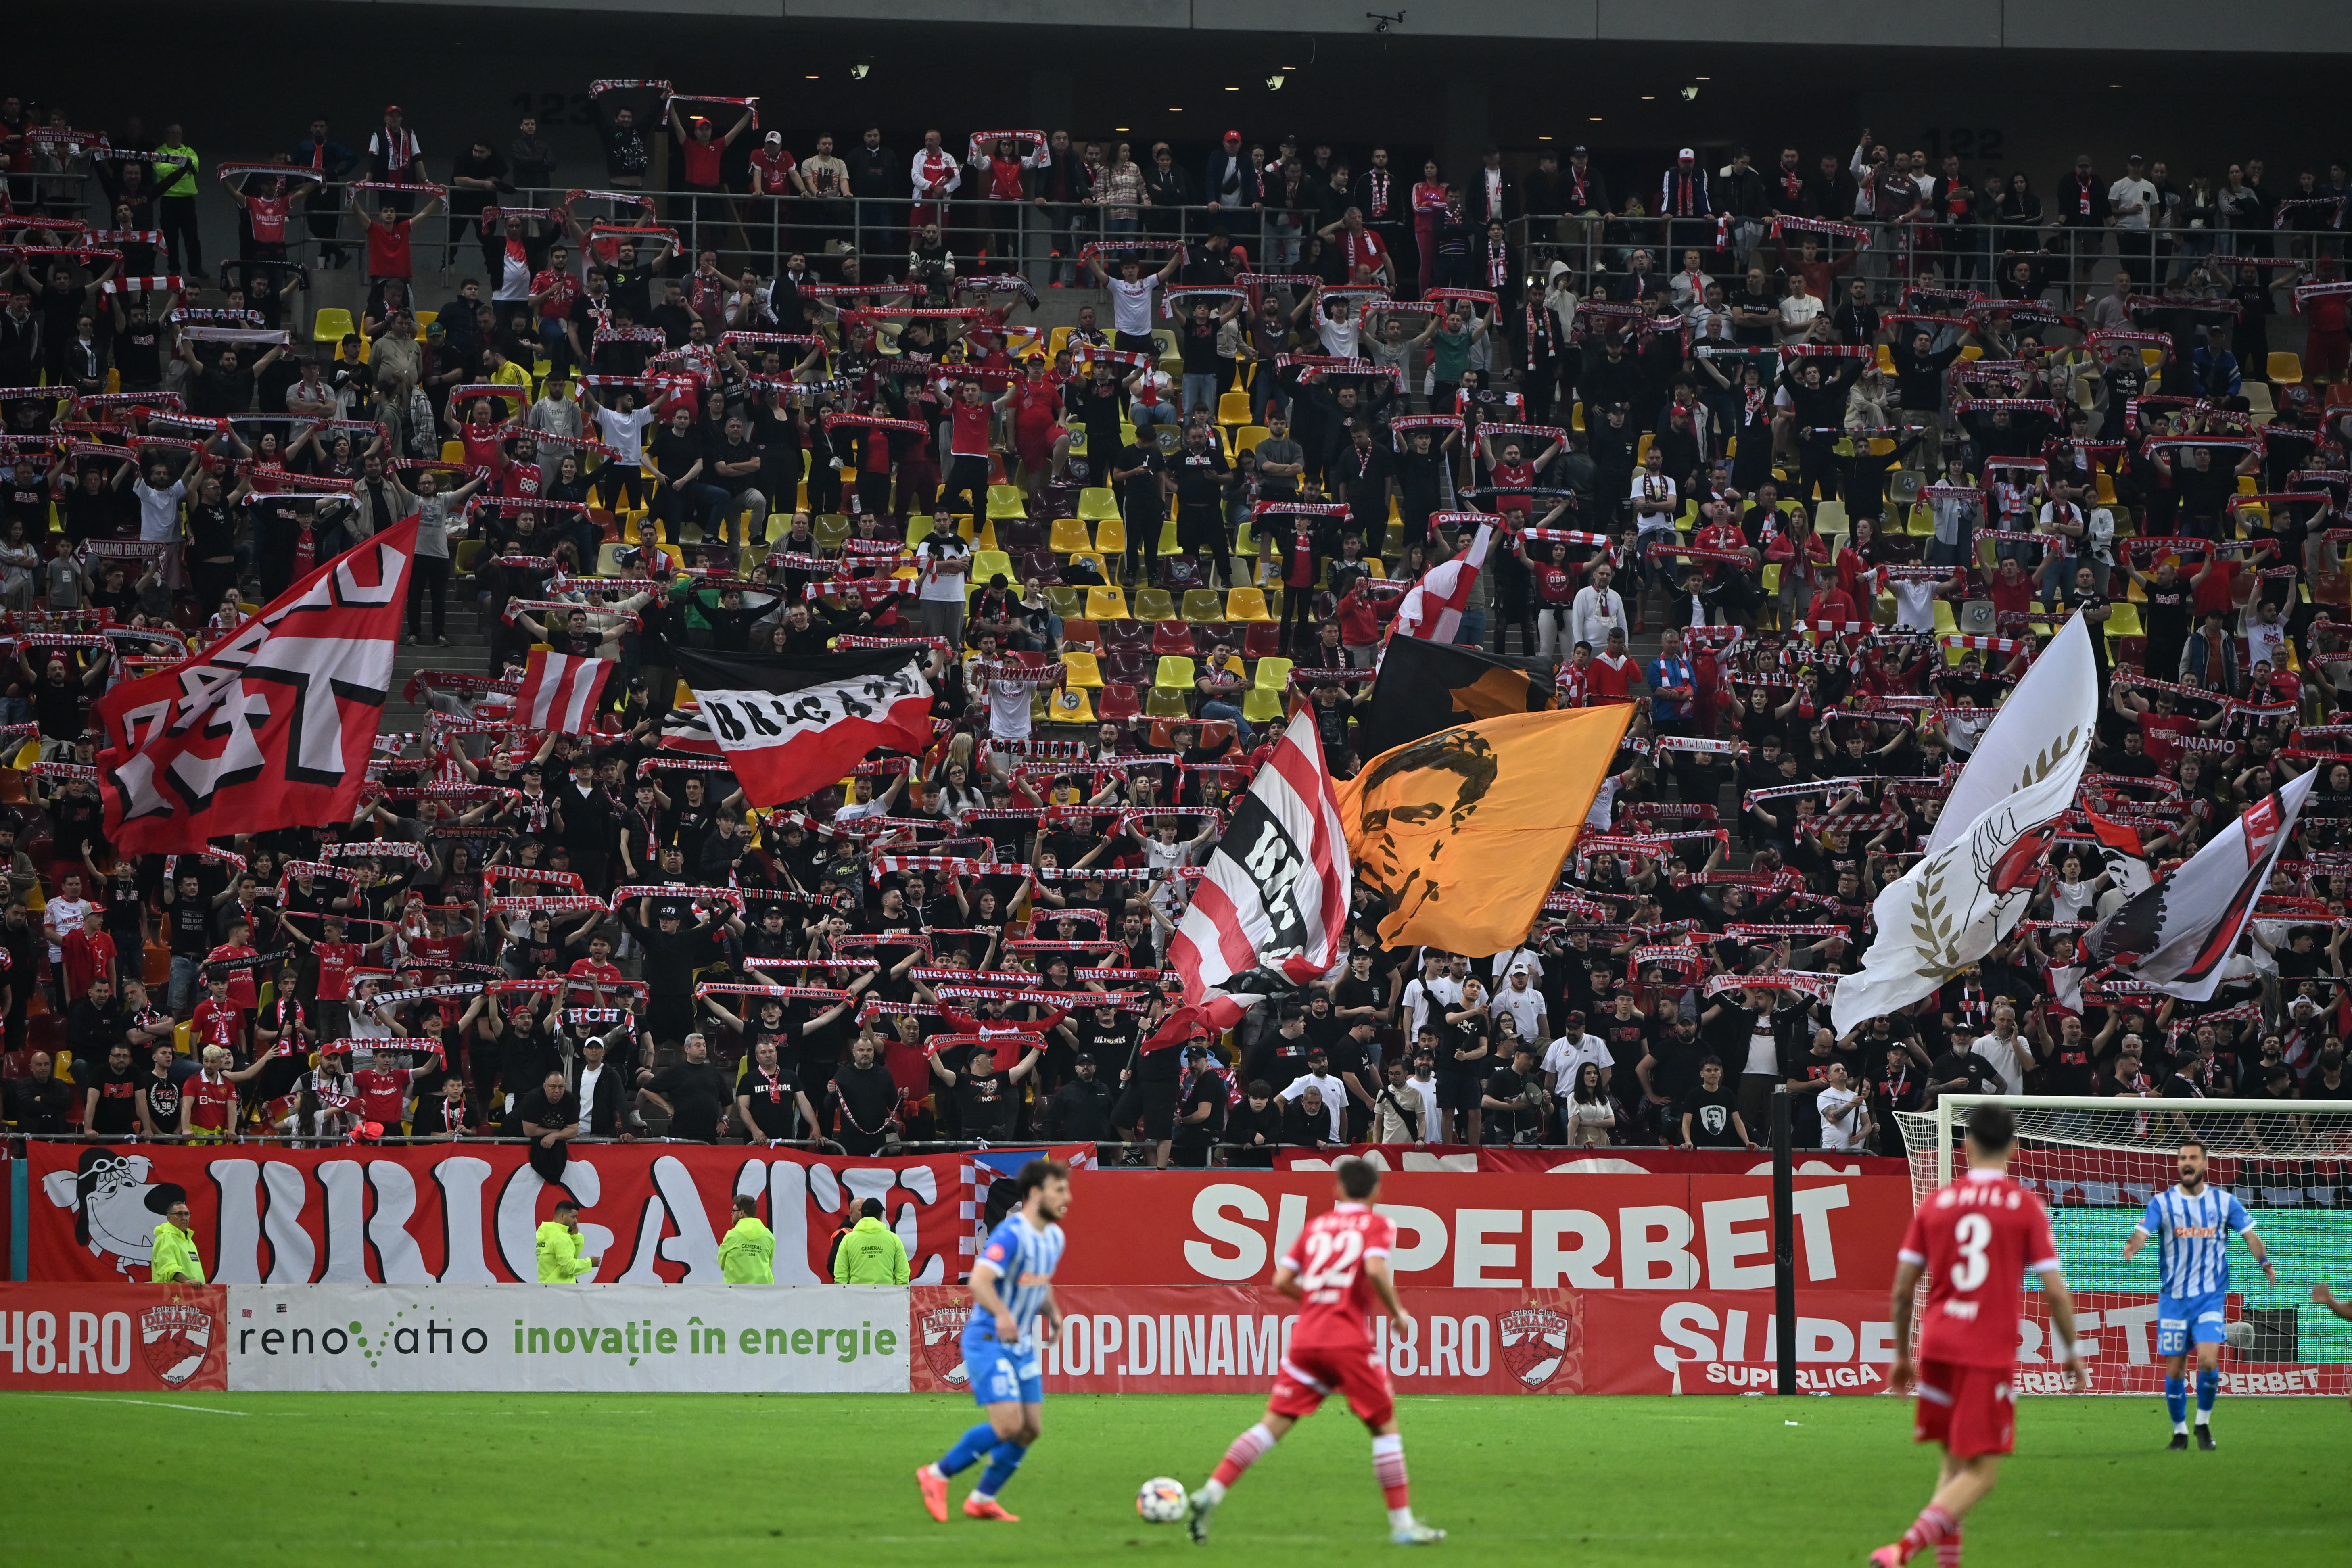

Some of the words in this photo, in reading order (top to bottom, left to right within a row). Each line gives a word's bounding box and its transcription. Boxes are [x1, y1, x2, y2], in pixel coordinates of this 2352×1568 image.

[100, 148, 188, 167] DINAMO
[1884, 184, 1909, 195] SUPERBET
[256, 213, 282, 222] UNIBET
[2218, 256, 2254, 265] FORZA
[173, 309, 260, 321] DINAMO
[95, 396, 169, 405] BUCURESTI
[149, 411, 217, 427] DINAMO
[520, 433, 599, 452] BUCURESTI
[520, 478, 539, 493] 888
[483, 500, 569, 509] BUCURESTI
[1438, 514, 1500, 525] DINAMO
[1975, 533, 2051, 545] BUCURESTI
[2131, 539, 2206, 549] DINAMO
[92, 542, 124, 556] DINAMO
[125, 542, 162, 556] BUCURES
[31, 638, 115, 654] BUCURESTI
[1797, 651, 1839, 666] PCH
[1000, 666, 1054, 679] DINAMO
[440, 676, 462, 684] F.C.
[467, 679, 520, 692] DINAMO
[991, 741, 1027, 755] FORZA
[1030, 740, 1078, 755] DINAMO
[1107, 754, 1170, 764] DINAMO
[36, 762, 70, 772] DOAR
[44, 769, 98, 781] BUCURE
[396, 787, 418, 795] F.C.
[423, 787, 477, 795] DINAMO
[1628, 805, 1652, 815] F.C.
[1654, 804, 1702, 814] DINAMO
[2116, 806, 2150, 814] ULTRAS
[2152, 806, 2182, 814] GRUP
[435, 828, 498, 838] DINAMO
[330, 843, 417, 856] DINAMO
[495, 865, 572, 885] DINAMO
[836, 866, 858, 875] HRLM
[1048, 868, 1146, 879] DINAMO
[497, 896, 539, 905] DOAR
[542, 896, 596, 905] DINAMO
[660, 907, 676, 915] ICON
[1635, 947, 1698, 957] DINAMO
[911, 967, 971, 980] BRIGATE
[990, 973, 1042, 985] DINAMO
[1078, 969, 1138, 979] BRIGATE
[374, 983, 484, 1003] DINAMO
[709, 983, 765, 993] BRIGATE
[789, 988, 842, 998] DINAMO
[1019, 992, 1074, 1008] DINAMO
[567, 1008, 621, 1023] PCH
[935, 1034, 976, 1044] BRIGATE
[994, 1034, 1037, 1042] DINAMO
[350, 1043, 434, 1052] BUCURESTI
[104, 1082, 134, 1097] PCH
[370, 1086, 397, 1096] SUPERBET
[1950, 1212, 1992, 1291] 3
[1303, 1229, 1365, 1291] 22
[152, 1305, 178, 1313] Fotbal
[181, 1305, 201, 1313] Club
[1510, 1309, 1535, 1317] Fotbal
[143, 1311, 210, 1328] DINAMO
[924, 1314, 970, 1329] DINA
[1502, 1315, 1567, 1330] DINAMO
[515, 1319, 677, 1367] inovație
[687, 1316, 725, 1355] în
[740, 1321, 896, 1363] energie
[1654, 1301, 2158, 1372] SUPEET
[1031, 1313, 1491, 1376] HOP.DINAM8.RO
[168, 1375, 184, 1383] 1948
[949, 1376, 965, 1384] 1948
[2014, 1368, 2094, 1392] ERBET
[2184, 1368, 2319, 1393] PERBET
